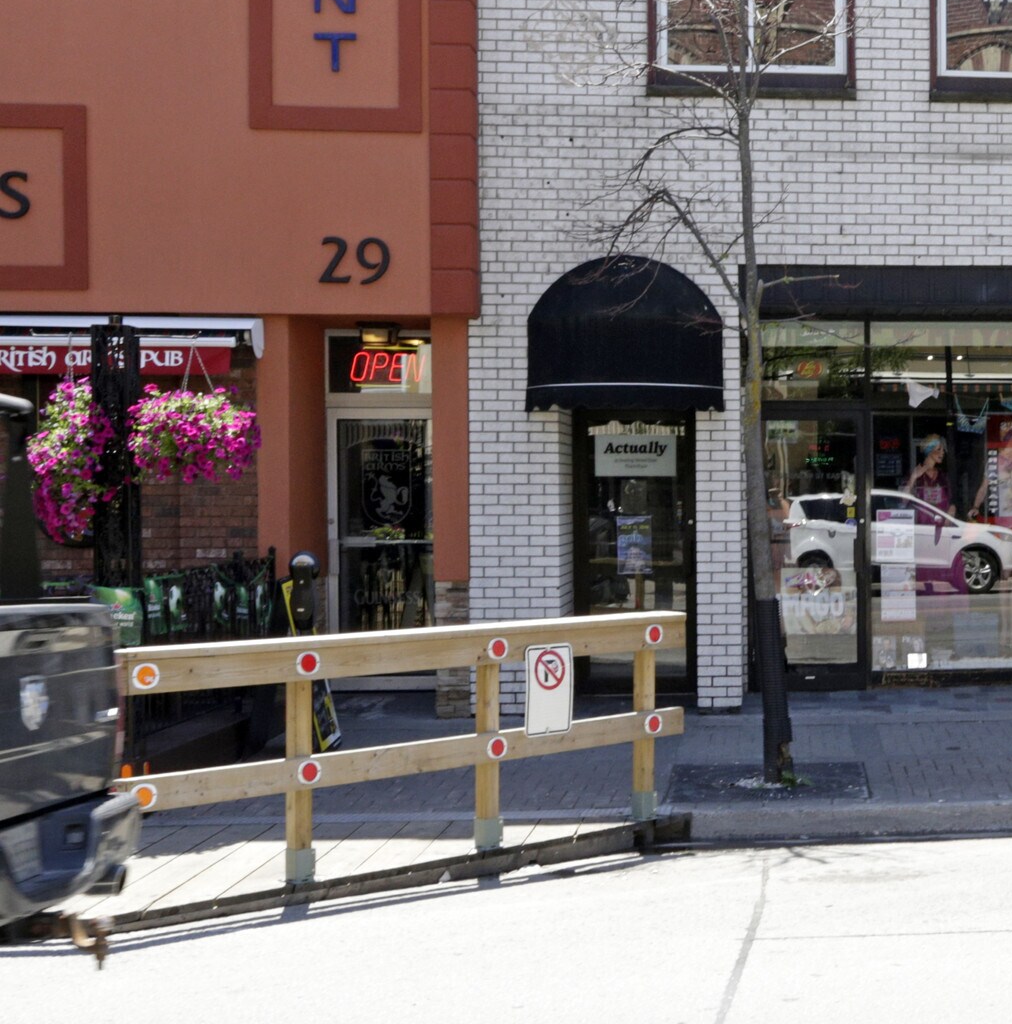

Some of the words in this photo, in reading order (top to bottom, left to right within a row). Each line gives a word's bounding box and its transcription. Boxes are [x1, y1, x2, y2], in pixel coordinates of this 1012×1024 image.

[318, 236, 391, 285] 29
[140, 349, 184, 369] PUB
[350, 351, 427, 382] OPEN
[603, 441, 668, 457] Actually
